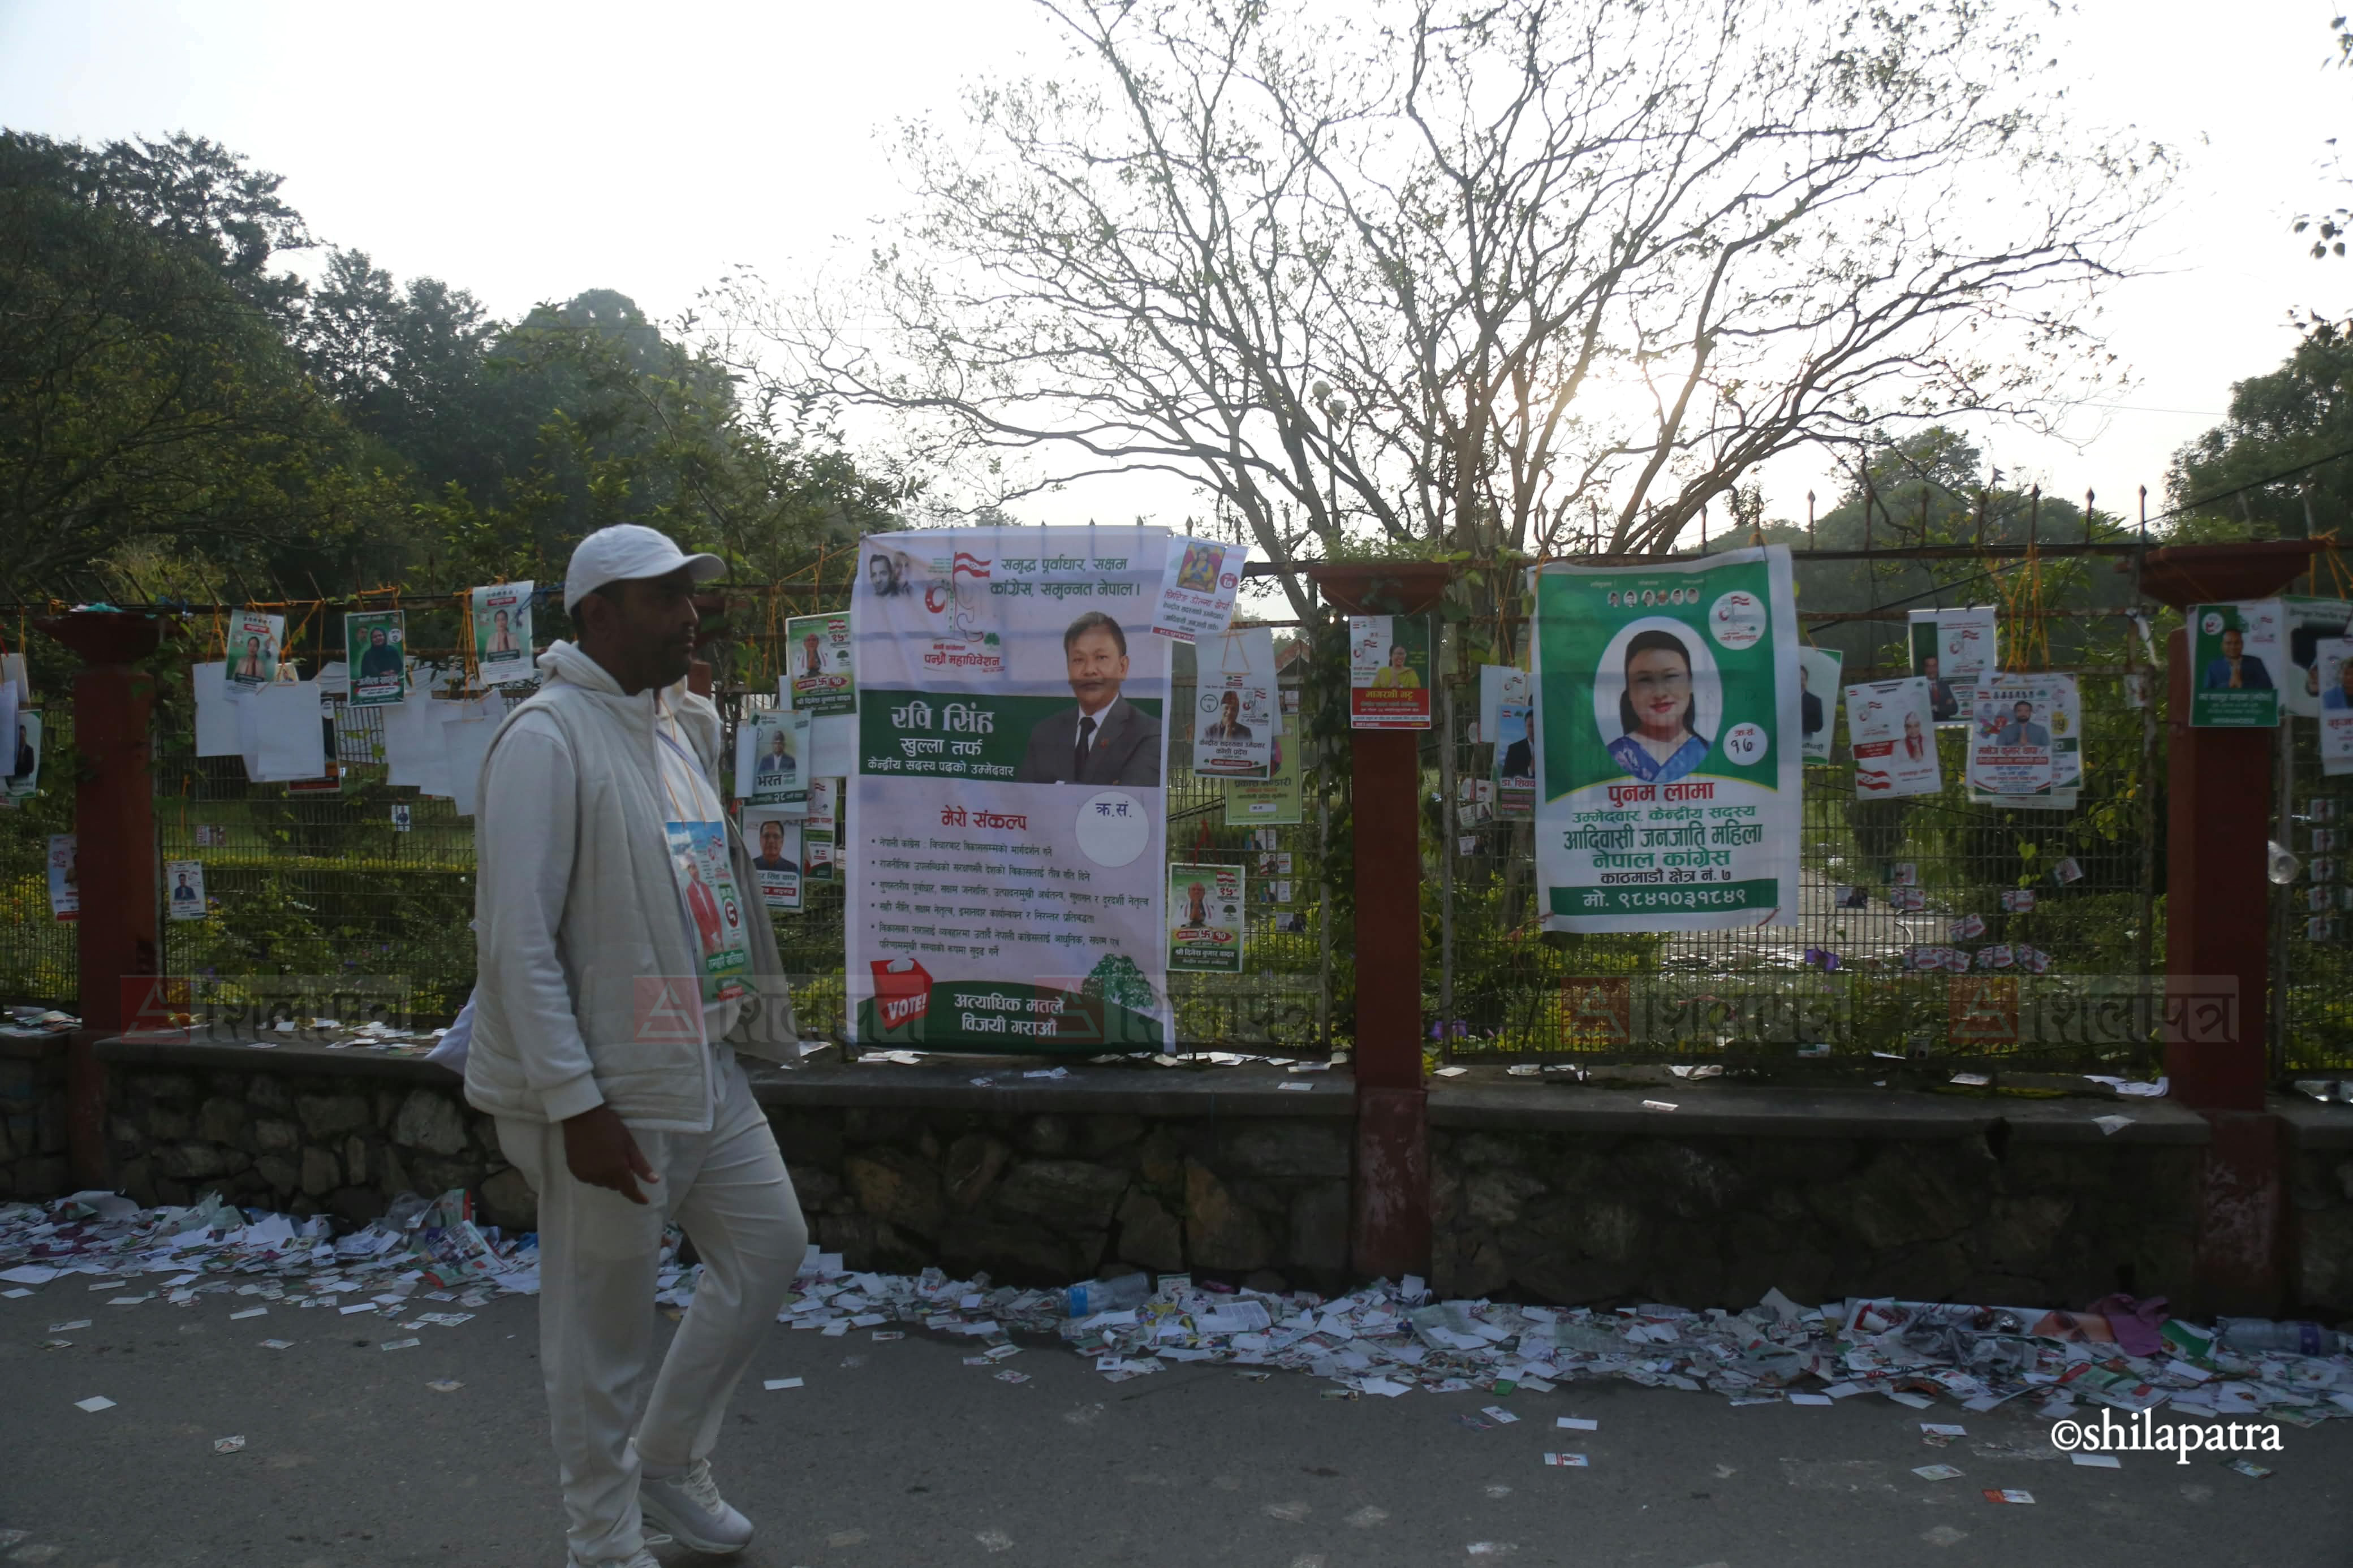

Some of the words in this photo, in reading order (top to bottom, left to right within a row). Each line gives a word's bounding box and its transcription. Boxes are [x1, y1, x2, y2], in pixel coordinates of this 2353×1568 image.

[1001, 559, 1037, 574] समृद्ध
[1041, 554, 1086, 574] पूर्वाधार,
[1093, 558, 1128, 572] सक्षम
[990, 578, 1033, 598] कांग्रेस,
[1040, 582, 1093, 600] समुन्नत
[891, 701, 933, 729] रवि
[942, 702, 995, 733] सिंह
[900, 738, 945, 757] खुल्ला
[951, 739, 982, 756] तर्फ
[868, 756, 901, 771] केन्द्रीय
[906, 760, 936, 772] सदस्य
[938, 760, 967, 773] पदको
[971, 762, 1014, 777] उम्मेदवार
[757, 775, 782, 787] भरत
[1608, 784, 1656, 807] पुनम
[1662, 782, 1714, 802] लामा
[941, 805, 967, 827] मेरो
[973, 811, 1027, 831] संकल्प
[1648, 806, 1703, 821] केन्द्रीय
[1709, 805, 1756, 819] सदस्य
[1563, 823, 1634, 850] आदिवासी
[1640, 820, 1706, 847] जनजाति
[1712, 819, 1763, 846] महिला
[1593, 850, 1655, 869] नेपाल
[1663, 846, 1731, 868] कांग्रेस
[1669, 867, 1696, 883] क्षेत्र
[1722, 870, 1731, 880] ७
[1583, 889, 1610, 907] मो.
[1618, 888, 1746, 908] ९८४१०३१८४९
[888, 994, 928, 1020] VOTE!
[954, 992, 1022, 1012] अत्याधिक
[1026, 996, 1065, 1014] मतले
[962, 1012, 1006, 1033] विजयी
